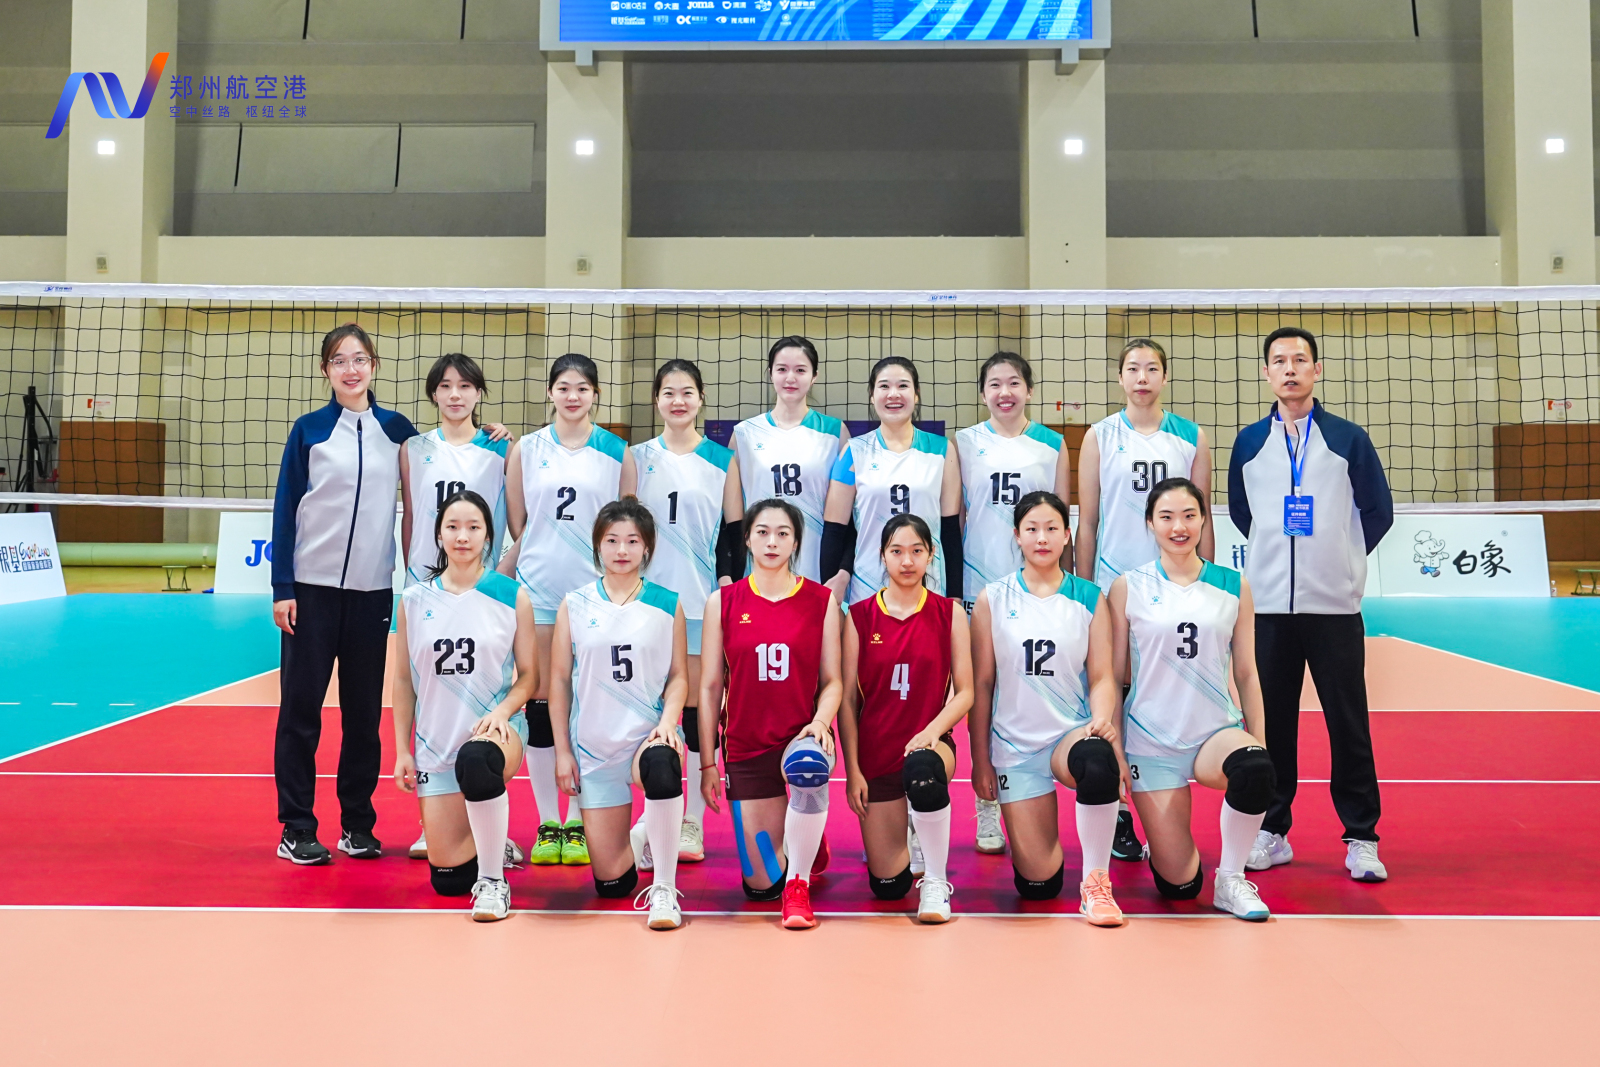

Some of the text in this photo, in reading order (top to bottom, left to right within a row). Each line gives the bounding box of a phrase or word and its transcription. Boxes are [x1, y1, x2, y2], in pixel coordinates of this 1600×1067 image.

[770, 463, 802, 497] 18
[989, 472, 1021, 506] 15
[1132, 460, 1168, 493] 30
[556, 486, 577, 521] 2
[667, 491, 679, 524] 1
[890, 483, 911, 516] 9
[1452, 539, 1512, 578] 白象
[433, 637, 475, 676] 23
[1022, 638, 1056, 677] 12
[1176, 622, 1198, 660] 3
[610, 644, 633, 683] 5
[755, 643, 790, 682] 19
[890, 663, 910, 701] 4
[998, 774, 1010, 791] 12
[1130, 764, 1140, 780] 3
